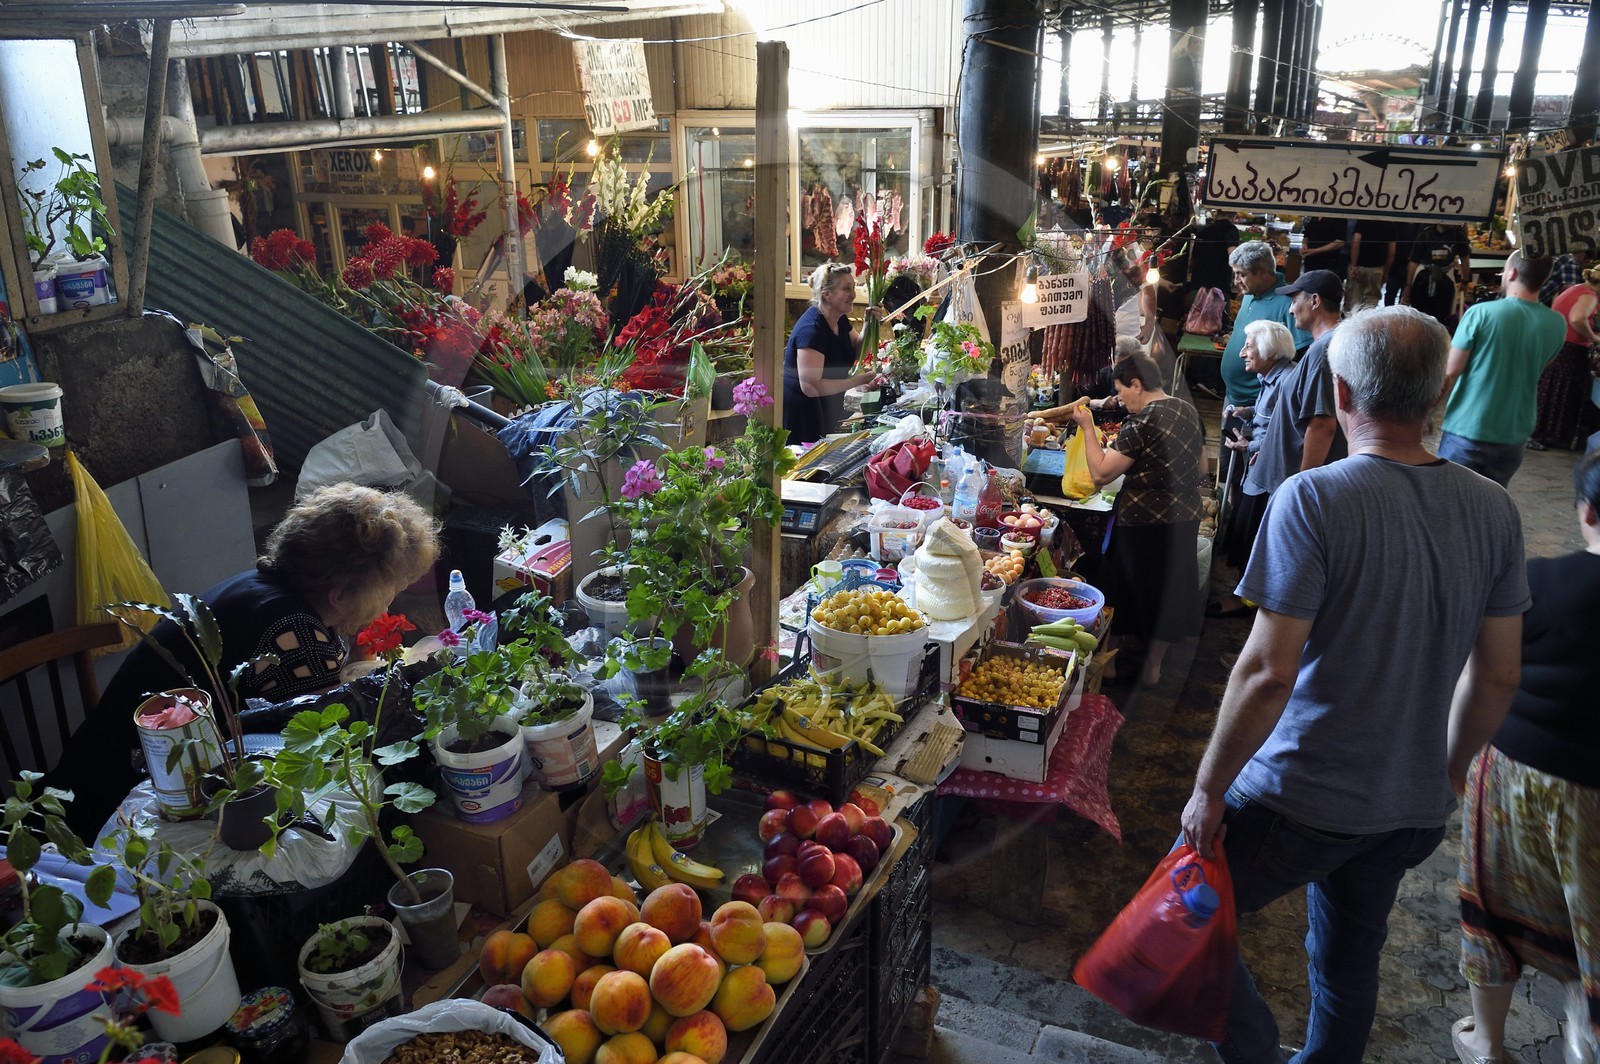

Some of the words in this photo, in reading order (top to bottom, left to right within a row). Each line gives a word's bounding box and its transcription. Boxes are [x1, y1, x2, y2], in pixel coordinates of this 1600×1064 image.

[612, 100, 631, 123] CD
[328, 151, 374, 172] XEROX
[1523, 208, 1600, 260] ვიდ
[1038, 277, 1075, 290] ბანანი
[1035, 290, 1083, 304] აბითუმო
[1040, 304, 1072, 316] ფასში
